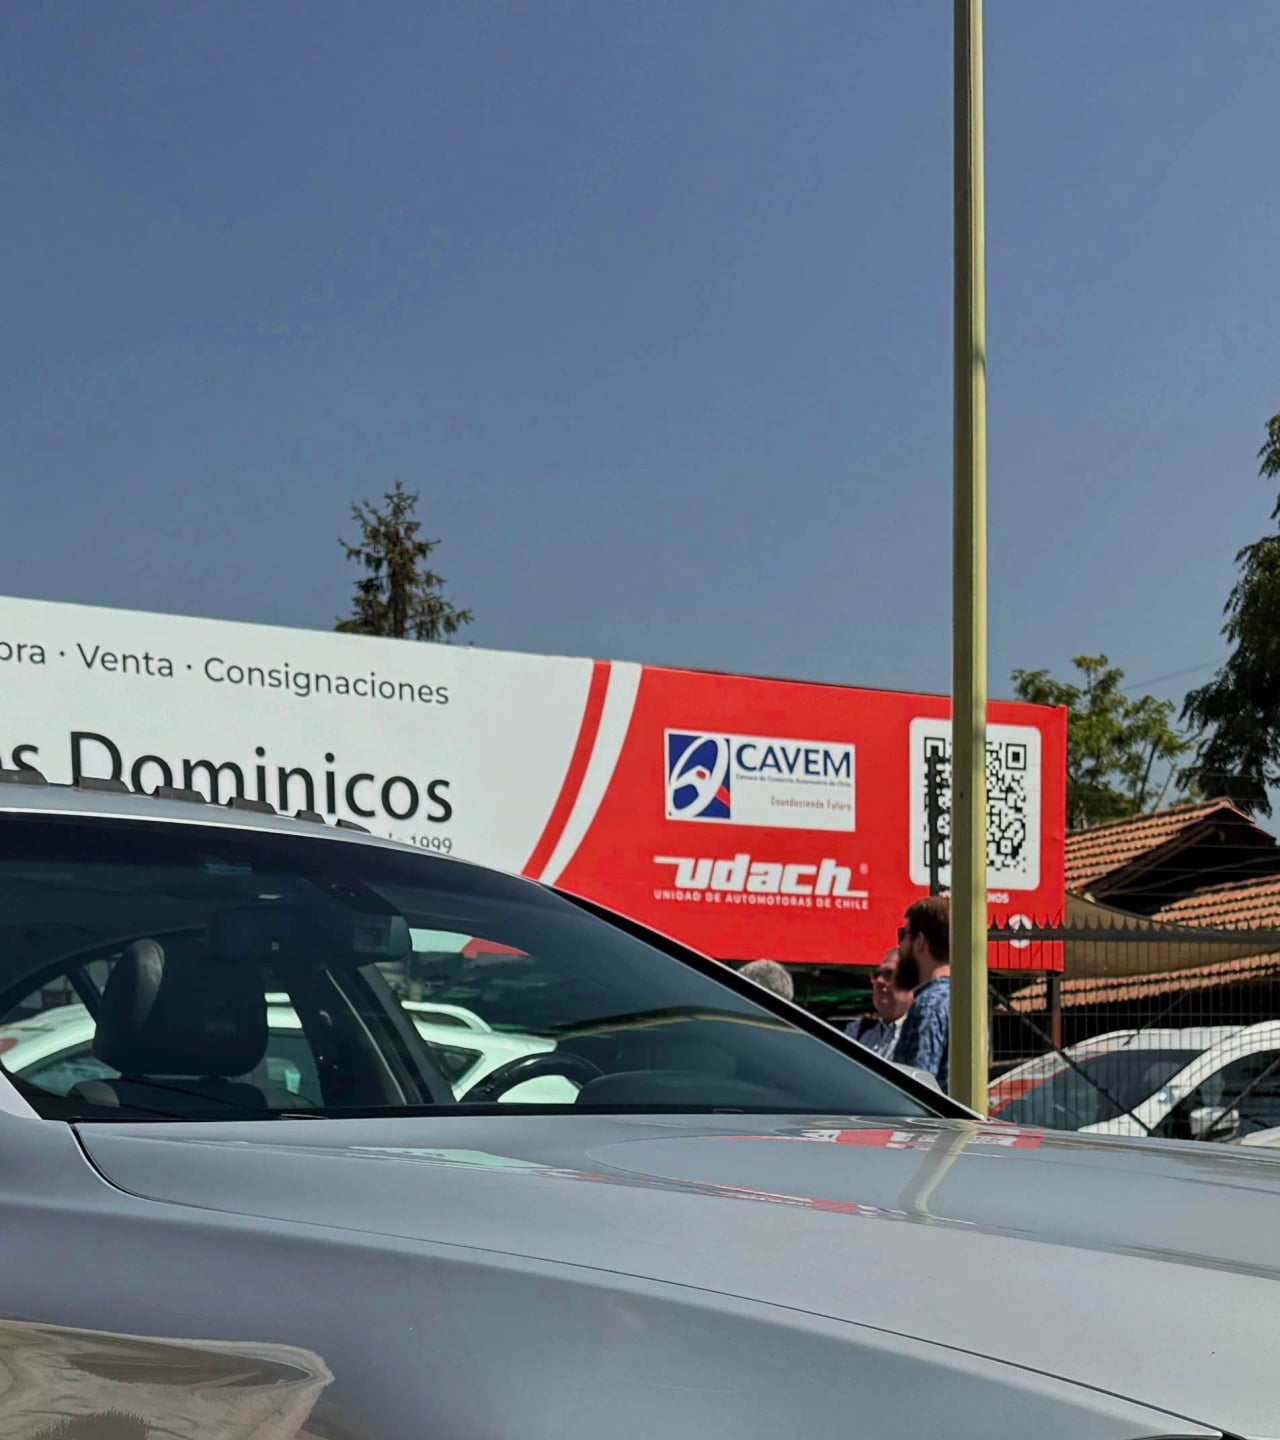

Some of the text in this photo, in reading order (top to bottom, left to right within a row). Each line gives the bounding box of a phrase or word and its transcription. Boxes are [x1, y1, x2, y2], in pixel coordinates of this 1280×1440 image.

[77, 644, 172, 677] Venta
[205, 658, 448, 704] Consignaciones
[70, 731, 453, 823] Dominicos
[736, 744, 850, 779] CAVEM
[653, 853, 869, 898] udach
[654, 889, 868, 910] UNIDAD DE AUTOMOTORAS DE CHILE
